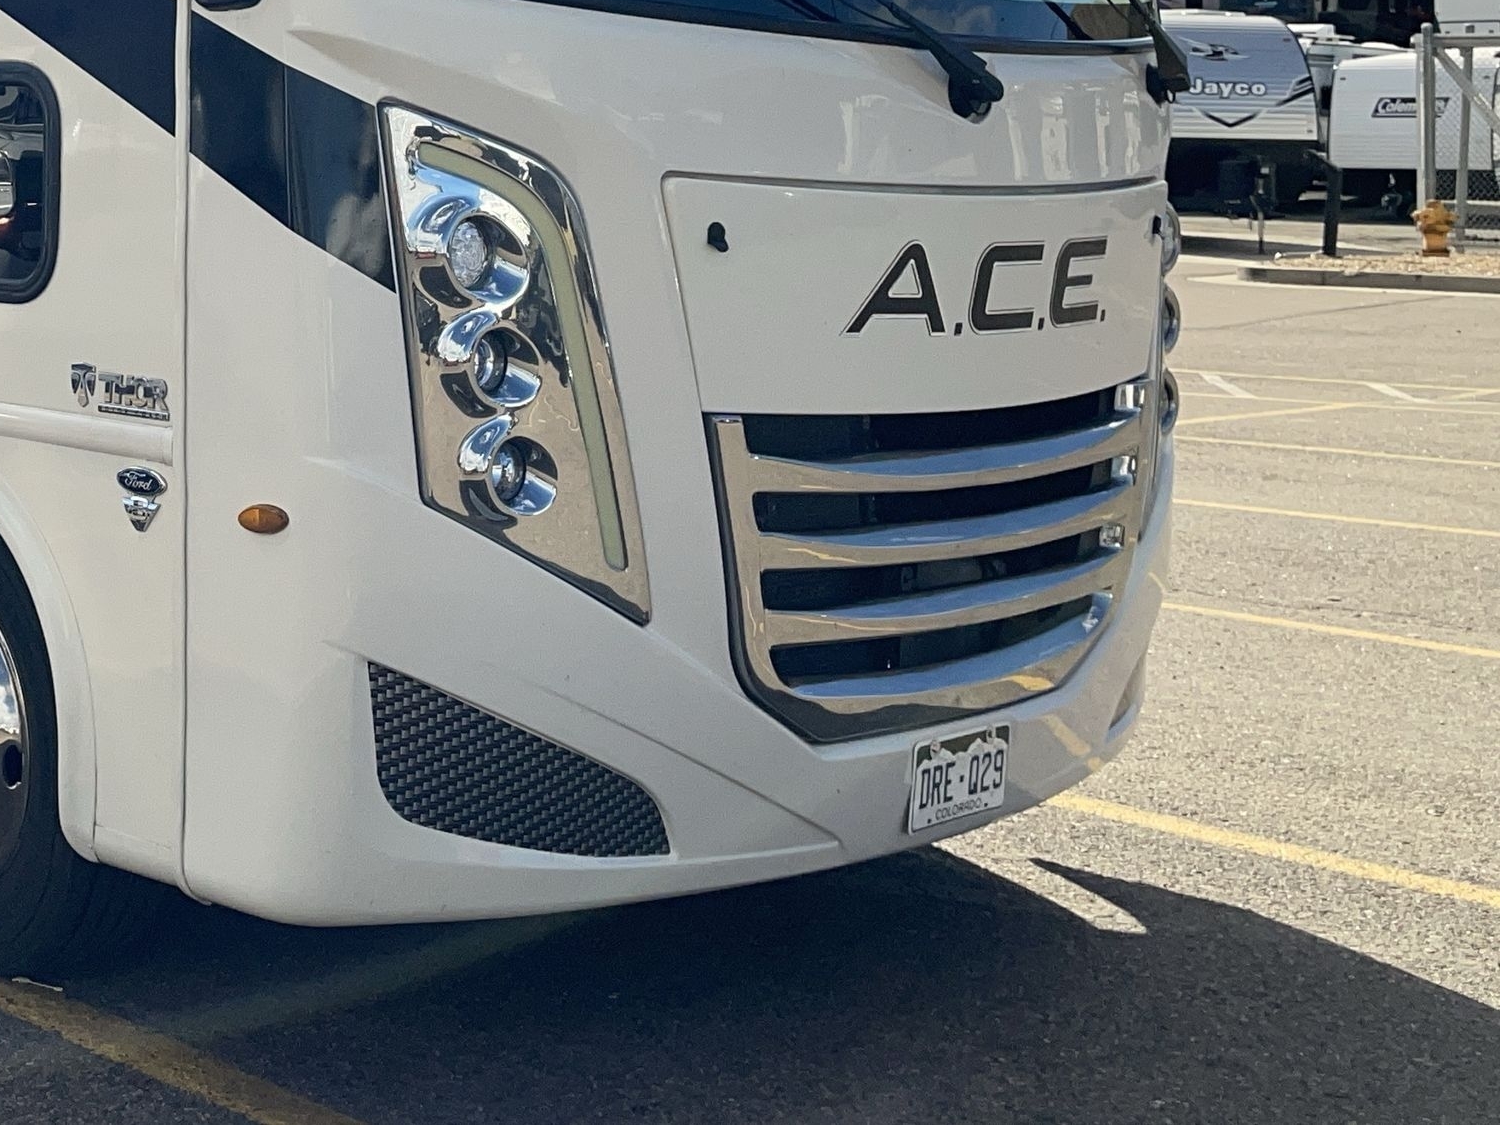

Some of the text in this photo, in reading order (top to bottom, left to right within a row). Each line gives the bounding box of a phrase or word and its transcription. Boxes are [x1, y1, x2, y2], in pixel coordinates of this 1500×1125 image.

[1189, 77, 1267, 99] Jayco
[839, 236, 1108, 337] A.C.E.
[99, 372, 169, 411] THOR
[124, 471, 153, 491] Ford
[935, 797, 982, 821] COLORADO
